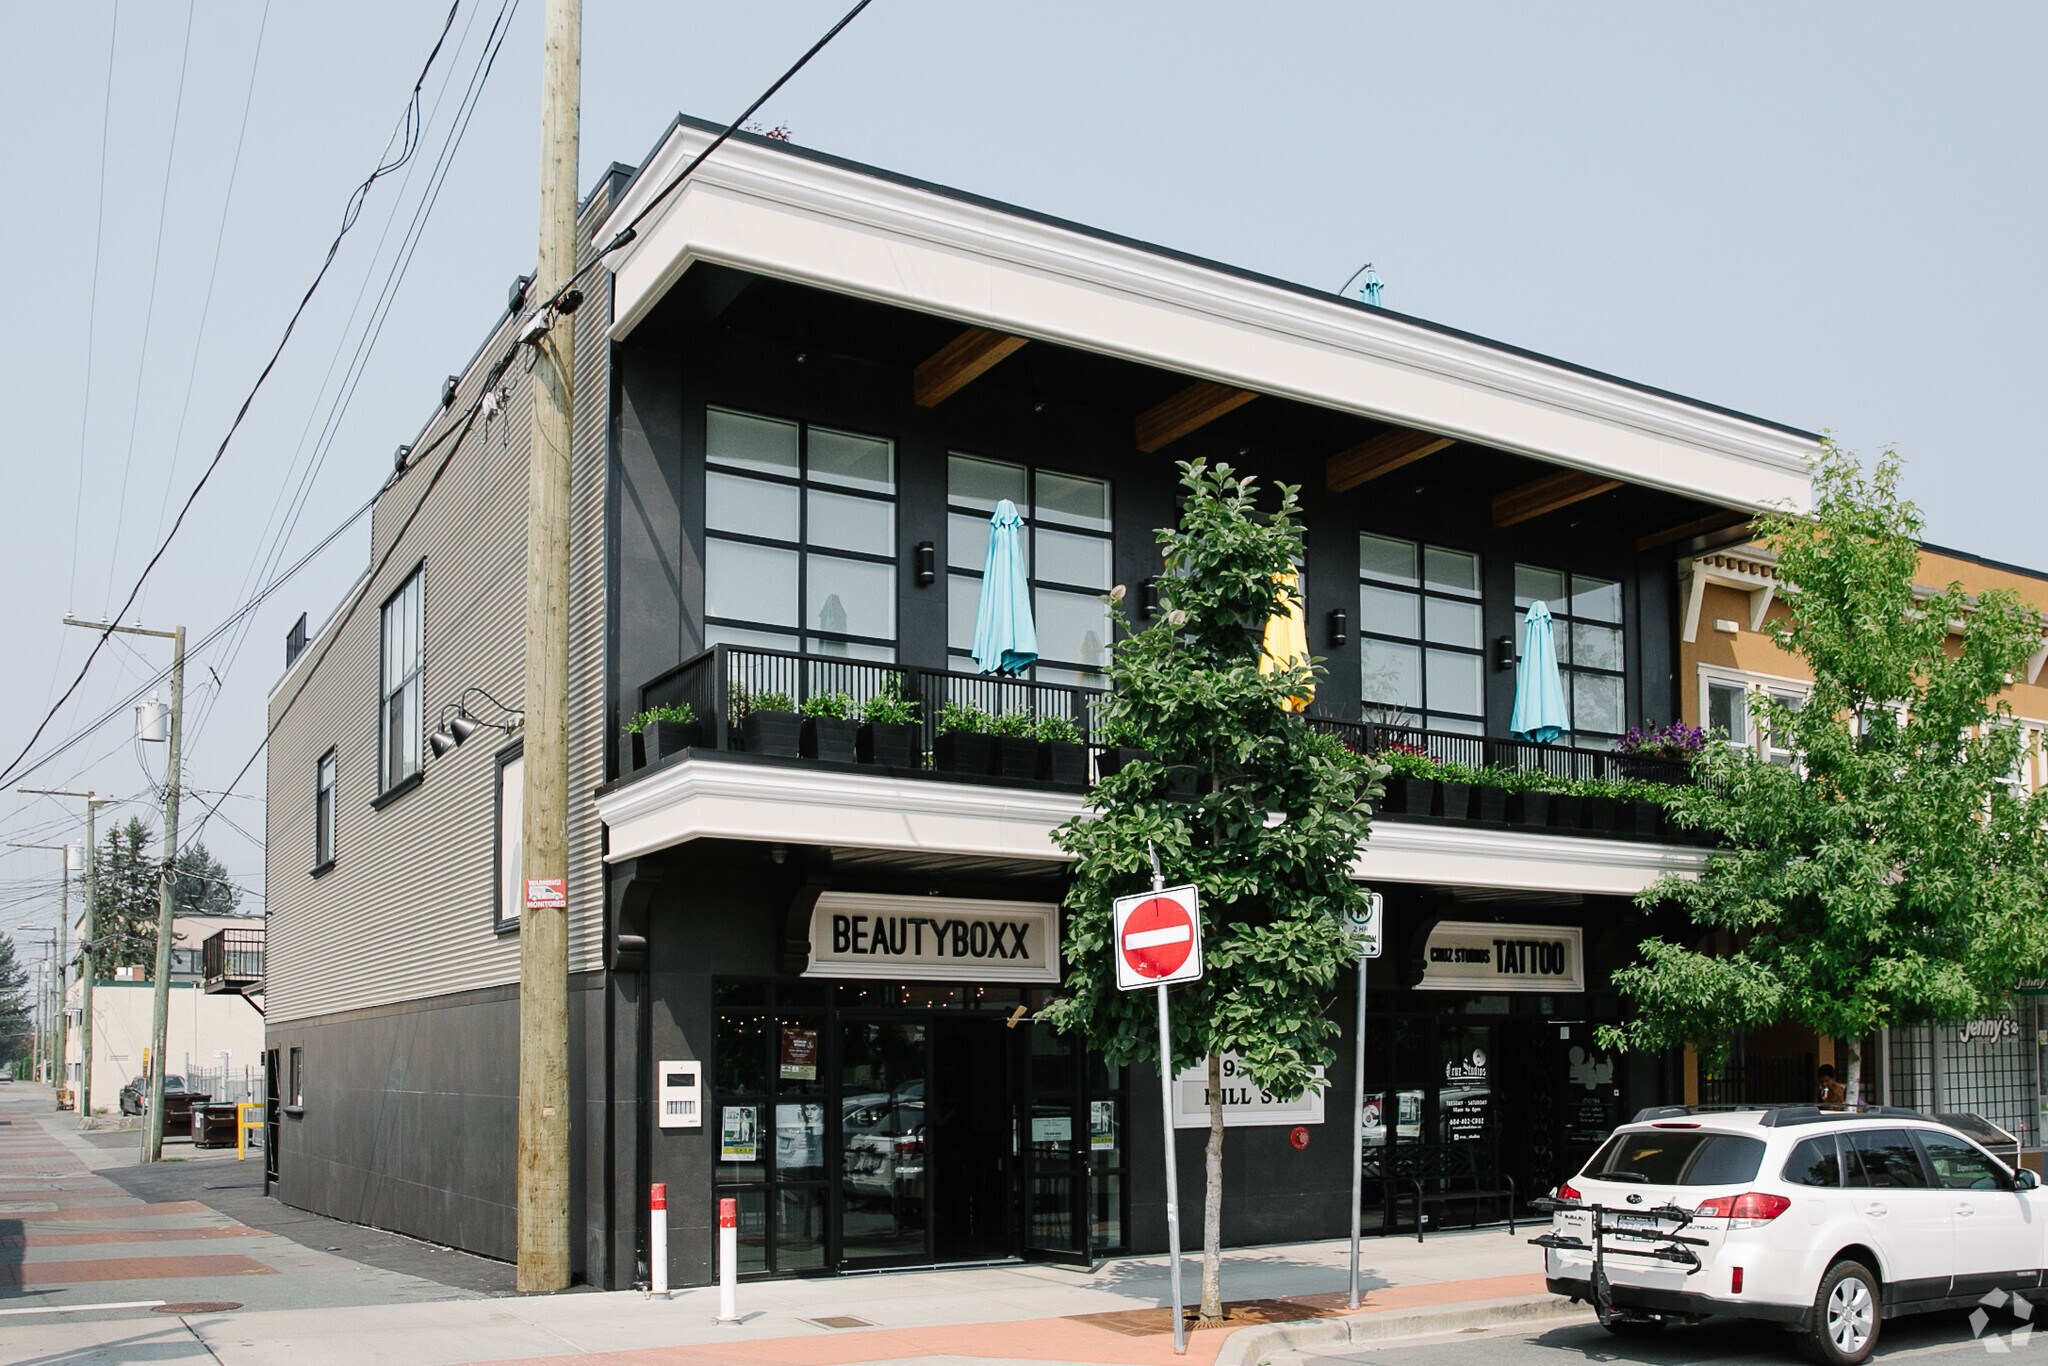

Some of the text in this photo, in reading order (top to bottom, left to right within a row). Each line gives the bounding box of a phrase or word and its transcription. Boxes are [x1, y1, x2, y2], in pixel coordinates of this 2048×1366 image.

[527, 900, 566, 908] MONITORED
[833, 915, 1030, 959] BEAUTYBOXX
[1353, 925, 1358, 933] 2
[1454, 948, 1491, 963] STUDIOS
[1492, 939, 1565, 975] TATTOO
[1959, 1014, 2010, 1044] Jenny's
